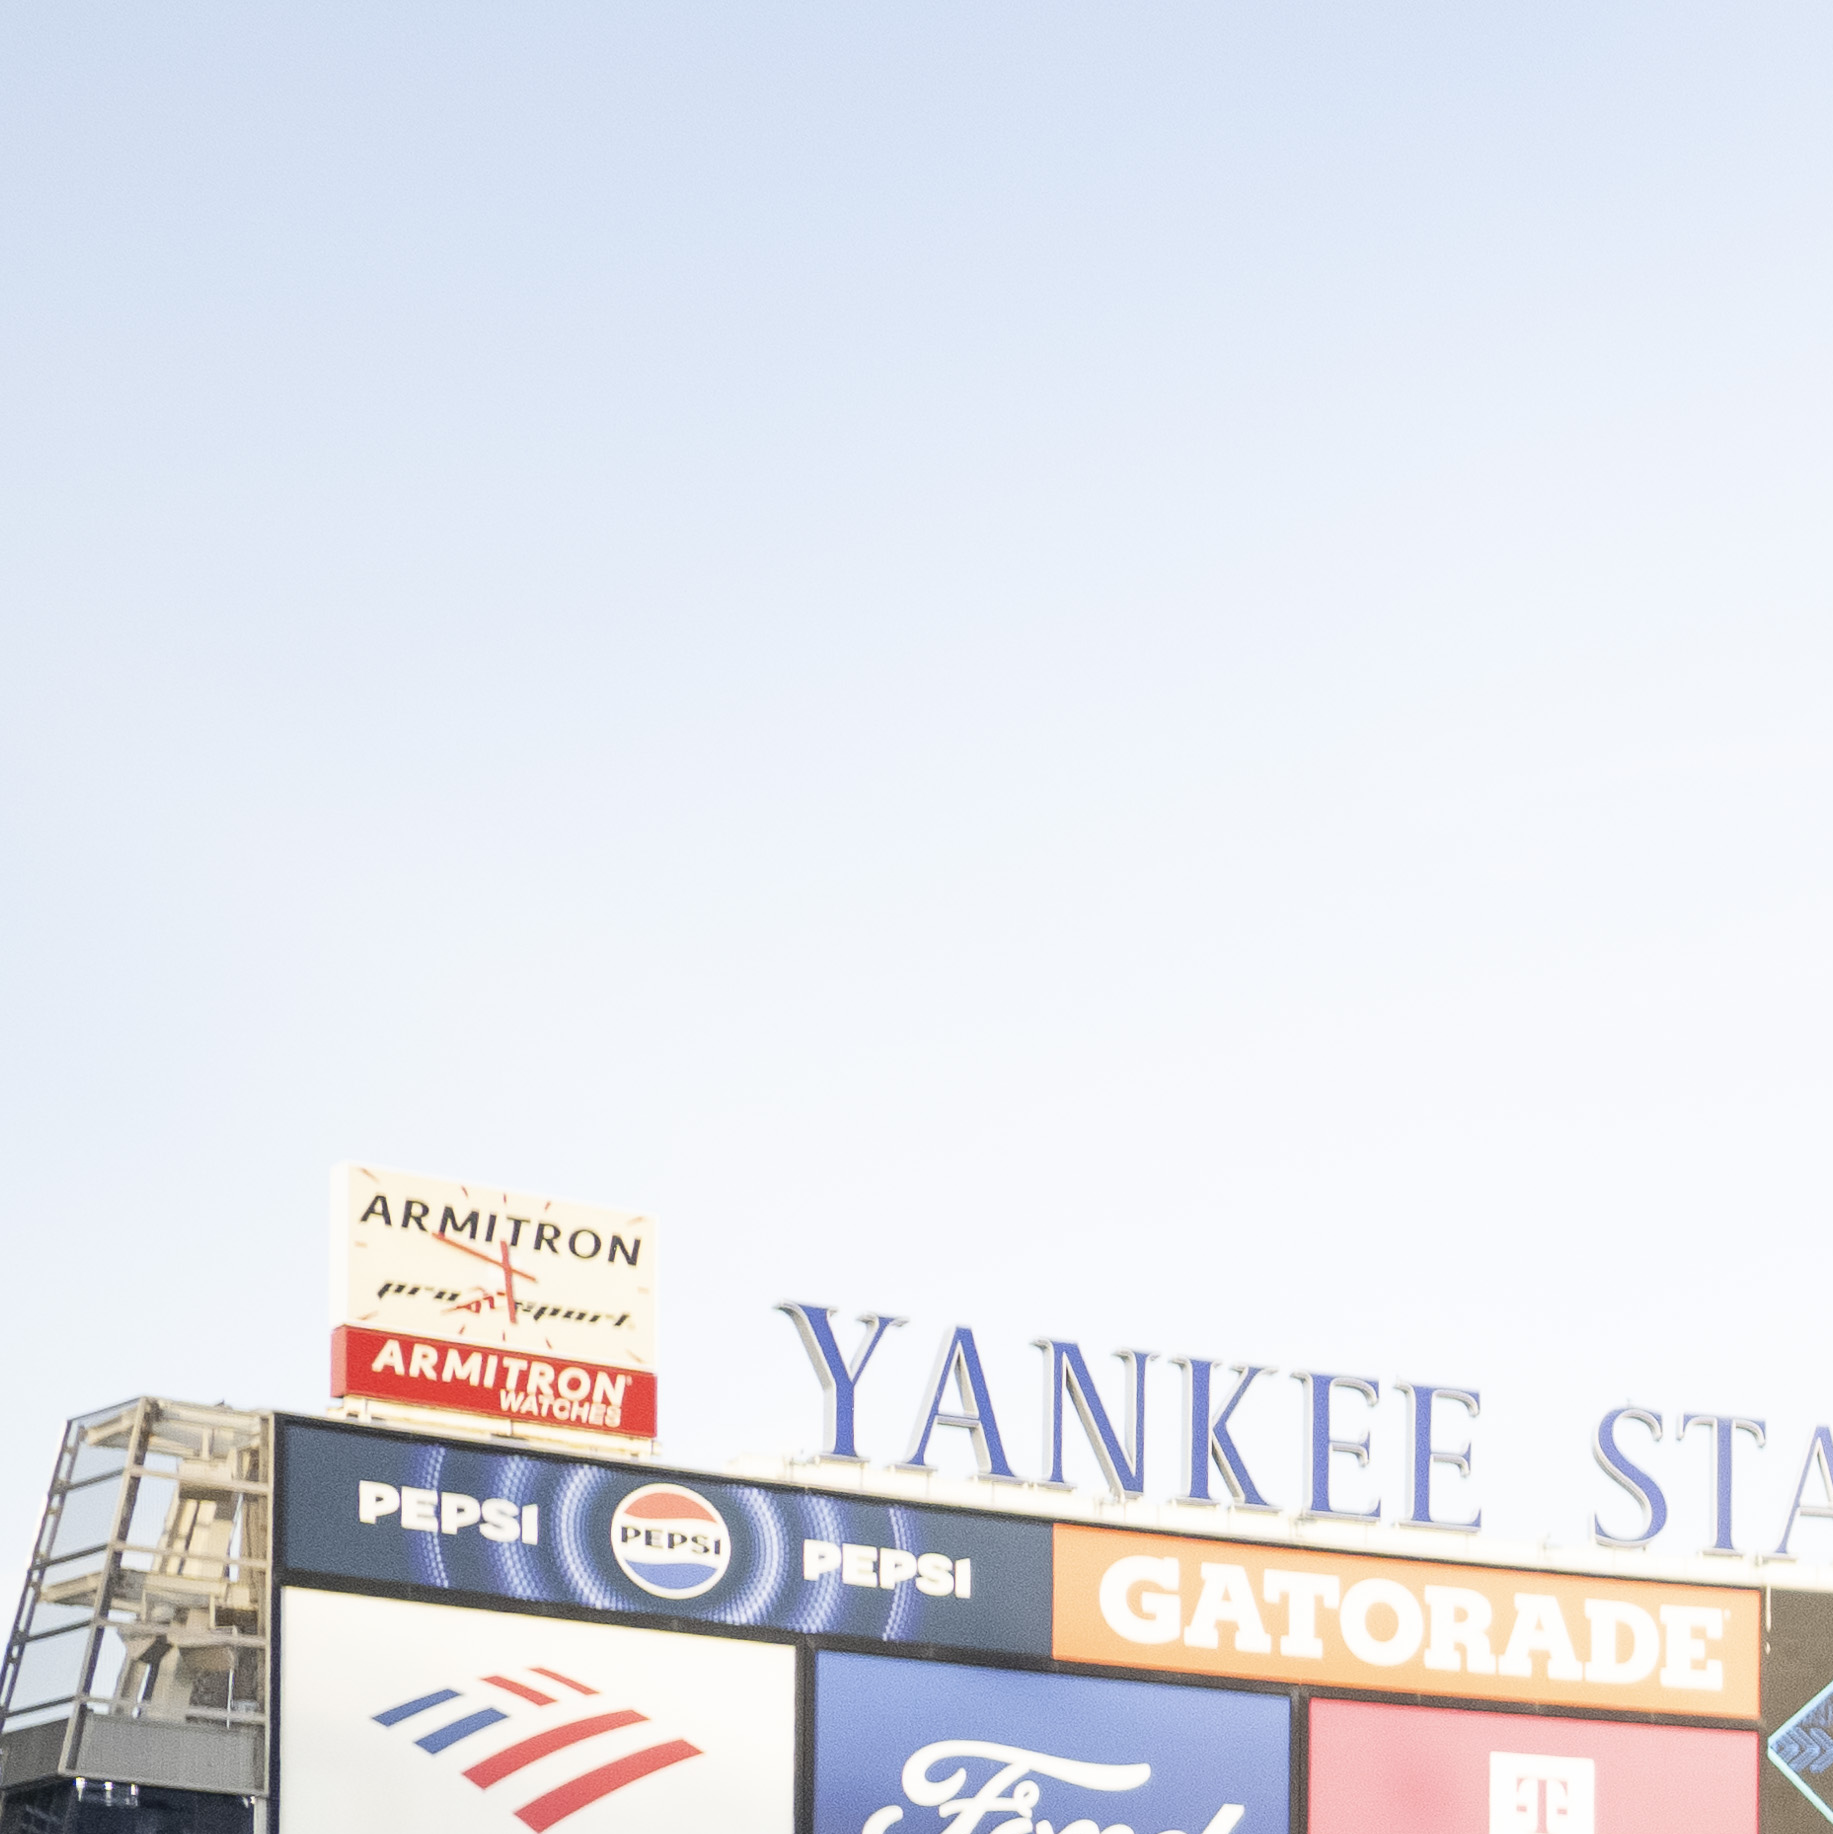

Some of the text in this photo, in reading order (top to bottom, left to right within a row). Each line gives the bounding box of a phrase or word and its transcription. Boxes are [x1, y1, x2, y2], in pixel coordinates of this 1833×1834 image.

[359, 1194, 642, 1267] ARMITRON
[371, 1338, 627, 1408] ARMITRON
[499, 1388, 622, 1429] WATCHES
[774, 1300, 1482, 1532] YANKEE
[357, 1480, 540, 1546] PEPSI
[619, 1526, 723, 1557] PEPSI
[802, 1540, 972, 1600] PEPSI
[1099, 1555, 1725, 1692] GATORADE
